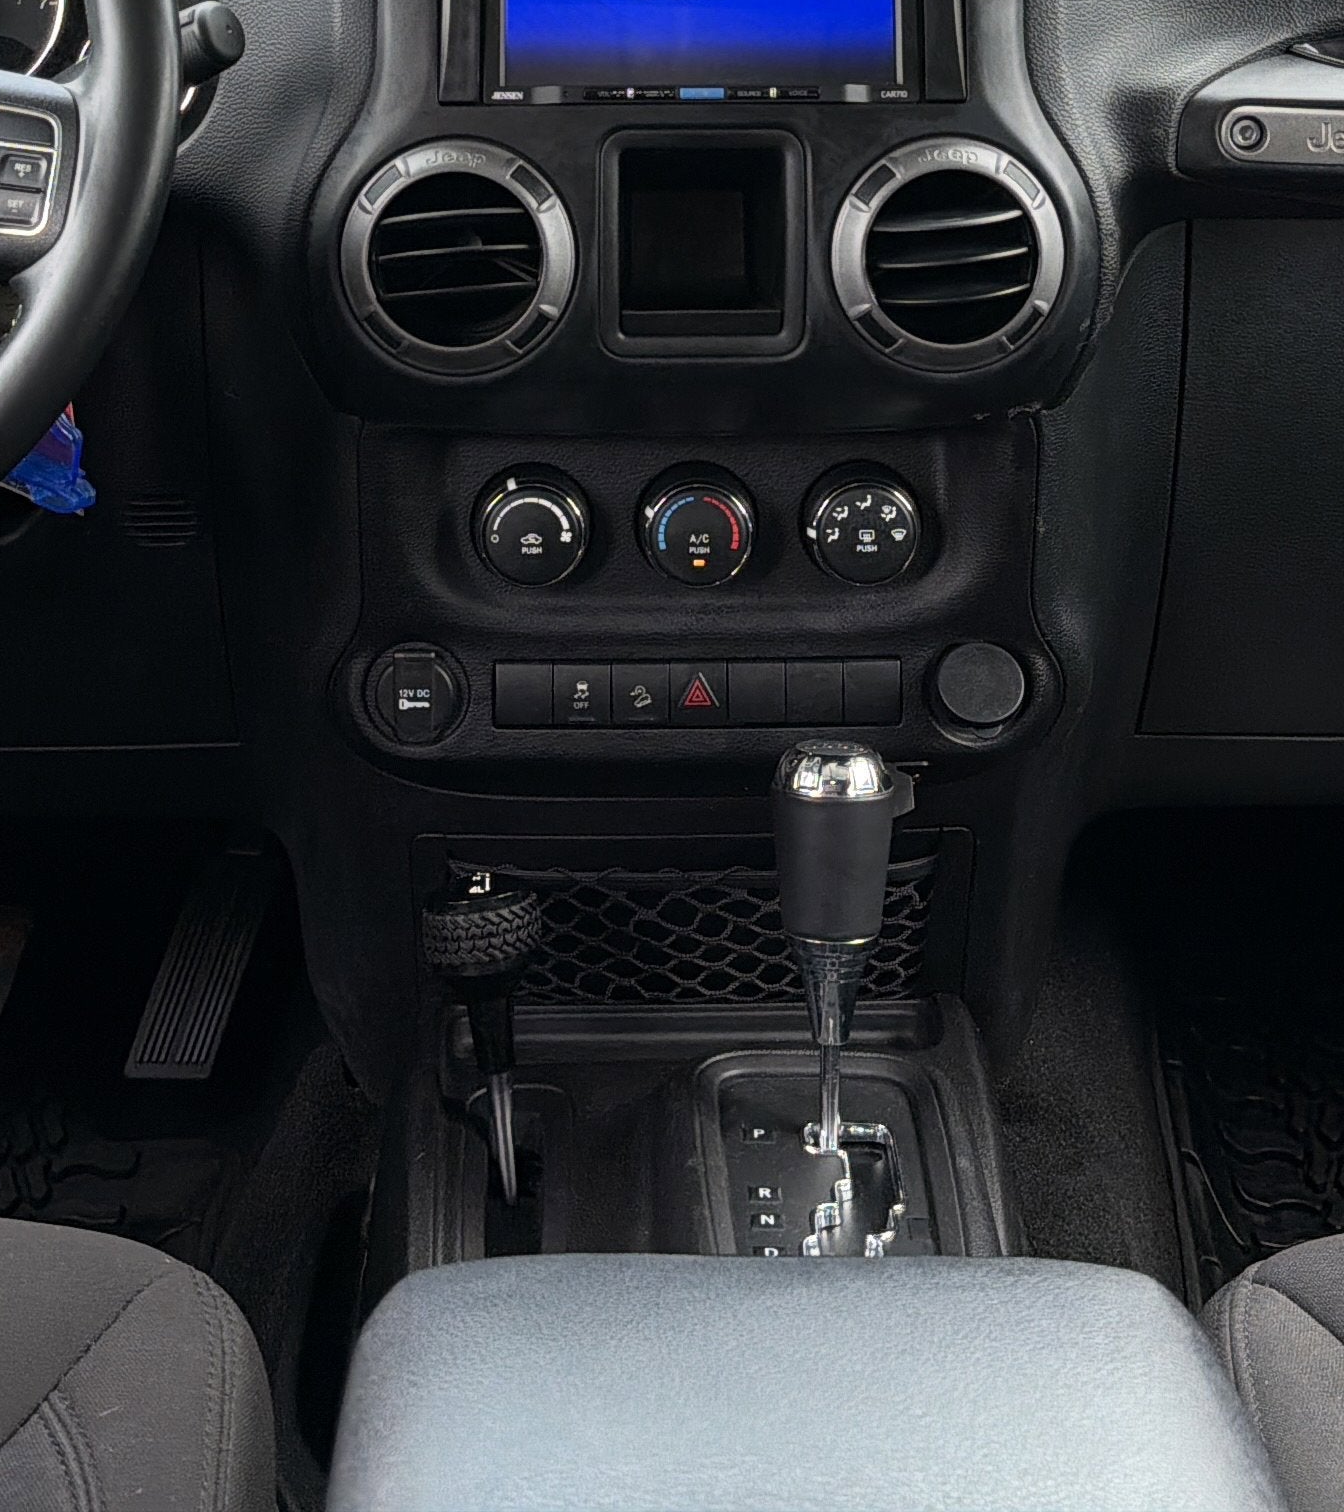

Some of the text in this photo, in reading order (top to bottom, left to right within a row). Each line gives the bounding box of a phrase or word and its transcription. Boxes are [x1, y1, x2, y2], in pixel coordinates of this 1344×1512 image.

[491, 91, 524, 101] JENSEN
[14, 162, 32, 173] RES
[7, 198, 25, 208] SET
[689, 533, 710, 544] A/C
[521, 546, 543, 555] PUSH
[688, 546, 710, 555] PUSH
[856, 544, 878, 553] PUSH
[398, 688, 431, 698] 12V DC
[573, 701, 590, 710] OFF
[753, 1128, 765, 1138] P
[758, 1187, 772, 1199] R
[760, 1214, 775, 1226] N
[764, 1247, 779, 1257] D
